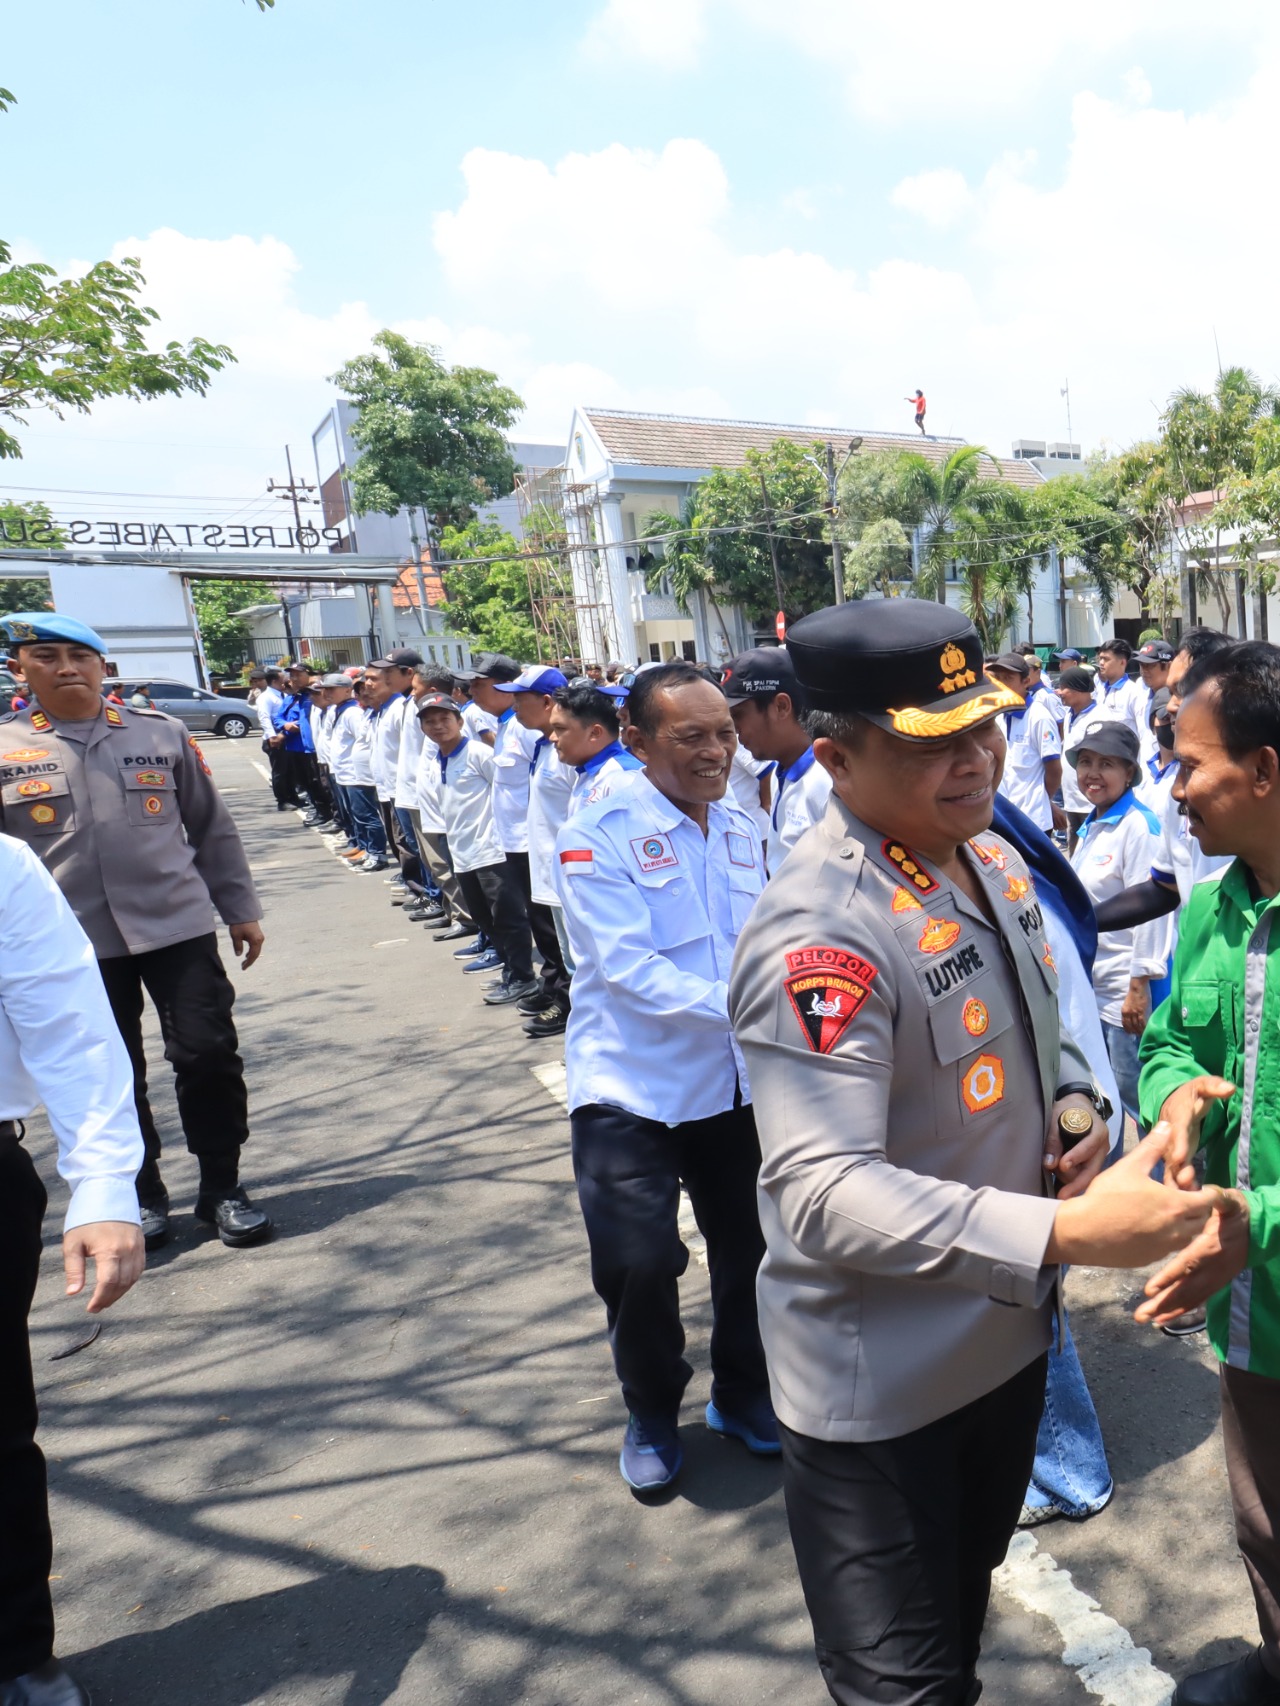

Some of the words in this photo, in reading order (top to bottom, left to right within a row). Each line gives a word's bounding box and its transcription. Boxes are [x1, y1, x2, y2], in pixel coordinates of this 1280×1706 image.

[124, 757, 168, 766] POLRI
[790, 950, 871, 980] PELOPOR
[925, 943, 984, 997] LUTHFIE
[791, 977, 825, 993] KORPS
[826, 977, 864, 998] BRIMOB
